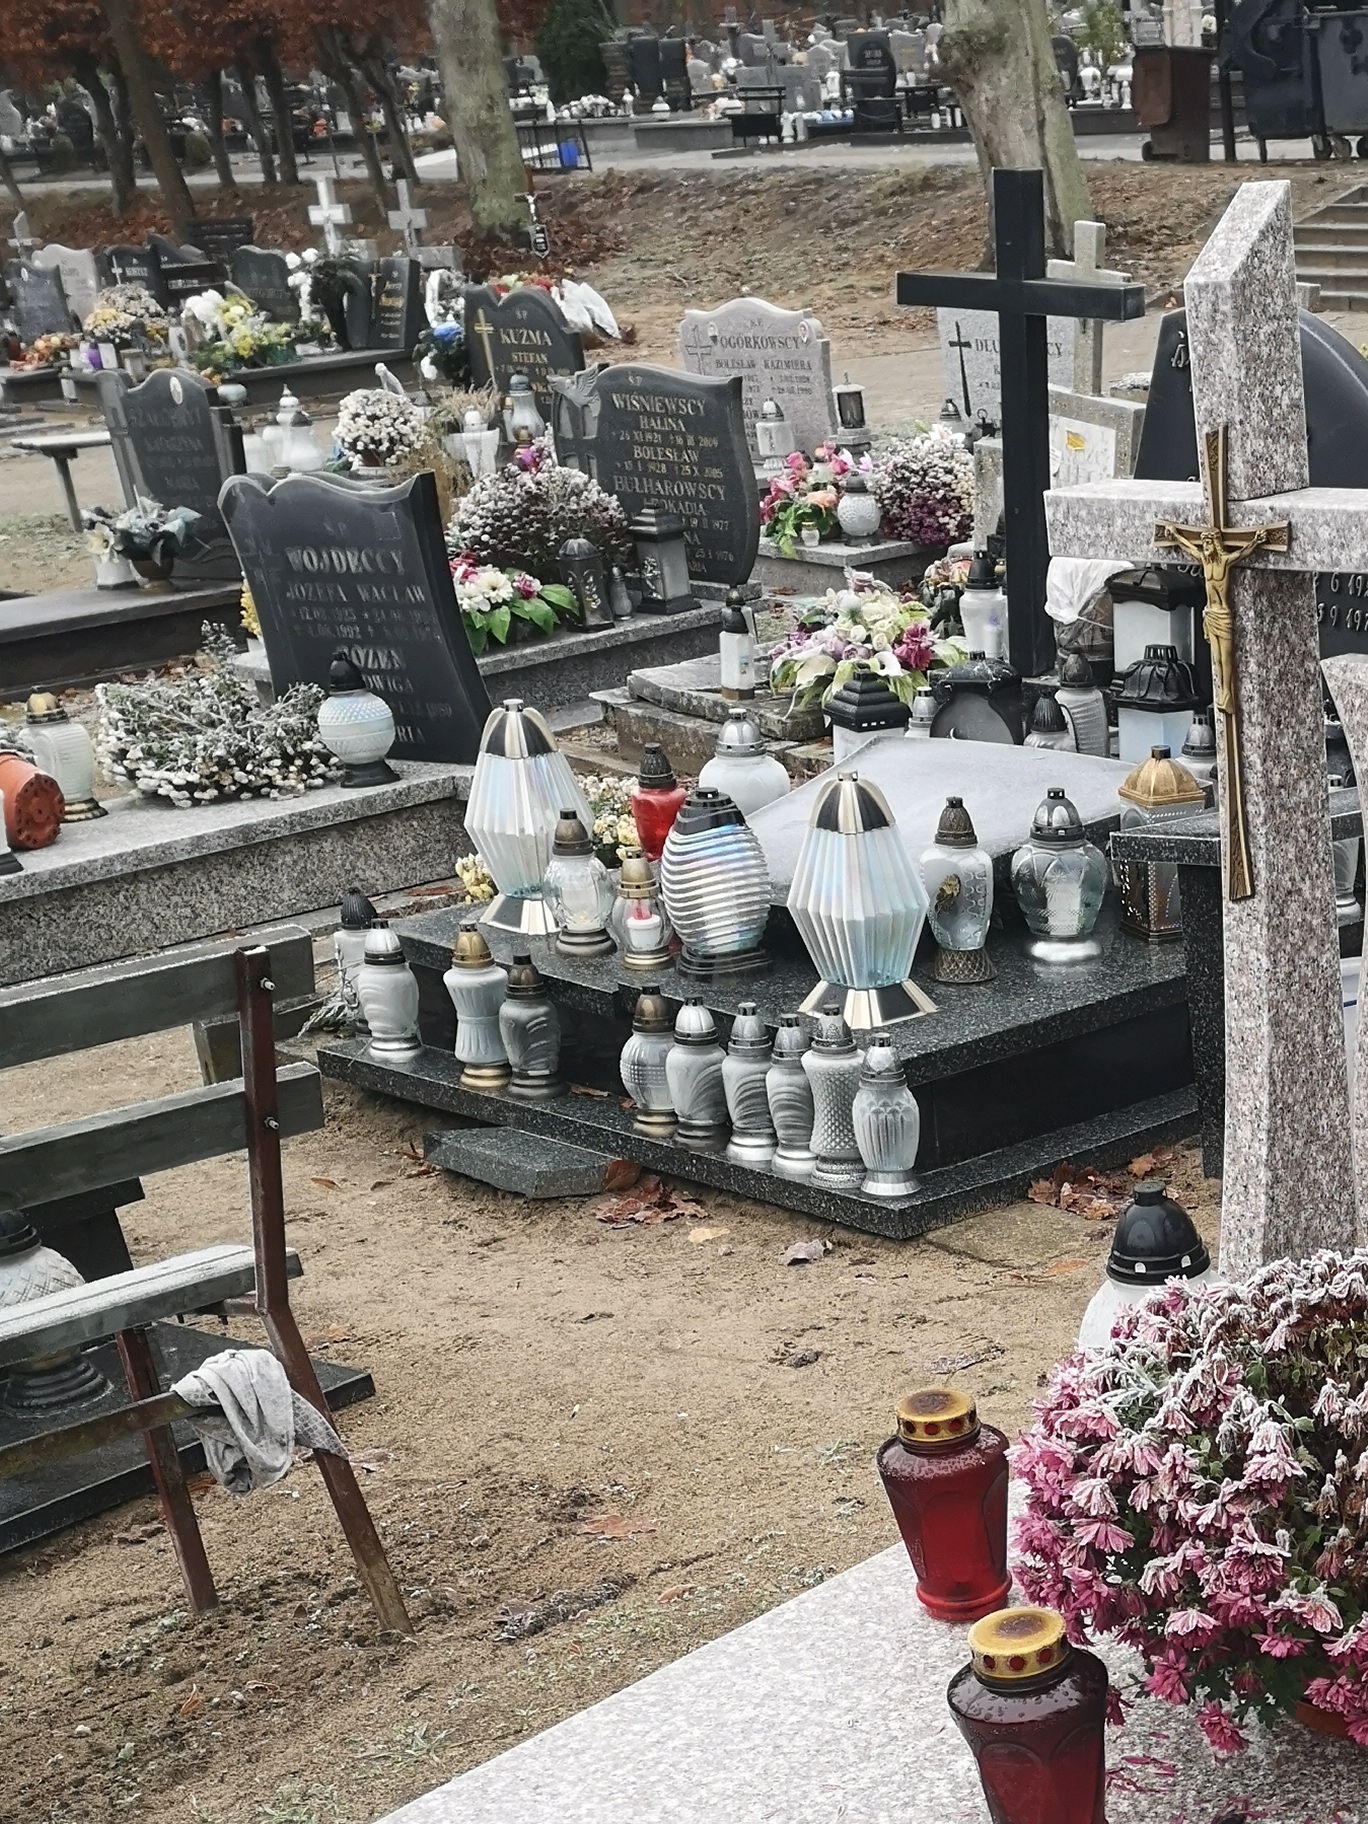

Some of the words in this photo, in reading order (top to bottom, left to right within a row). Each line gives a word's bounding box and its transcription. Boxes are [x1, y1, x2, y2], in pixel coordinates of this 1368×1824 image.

[720, 333, 800, 350] OGÓRKOWSCY
[612, 391, 707, 417] WIŚNIEWSCY
[639, 415, 686, 432] HALINA
[633, 445, 700, 464] BOLESŁAW
